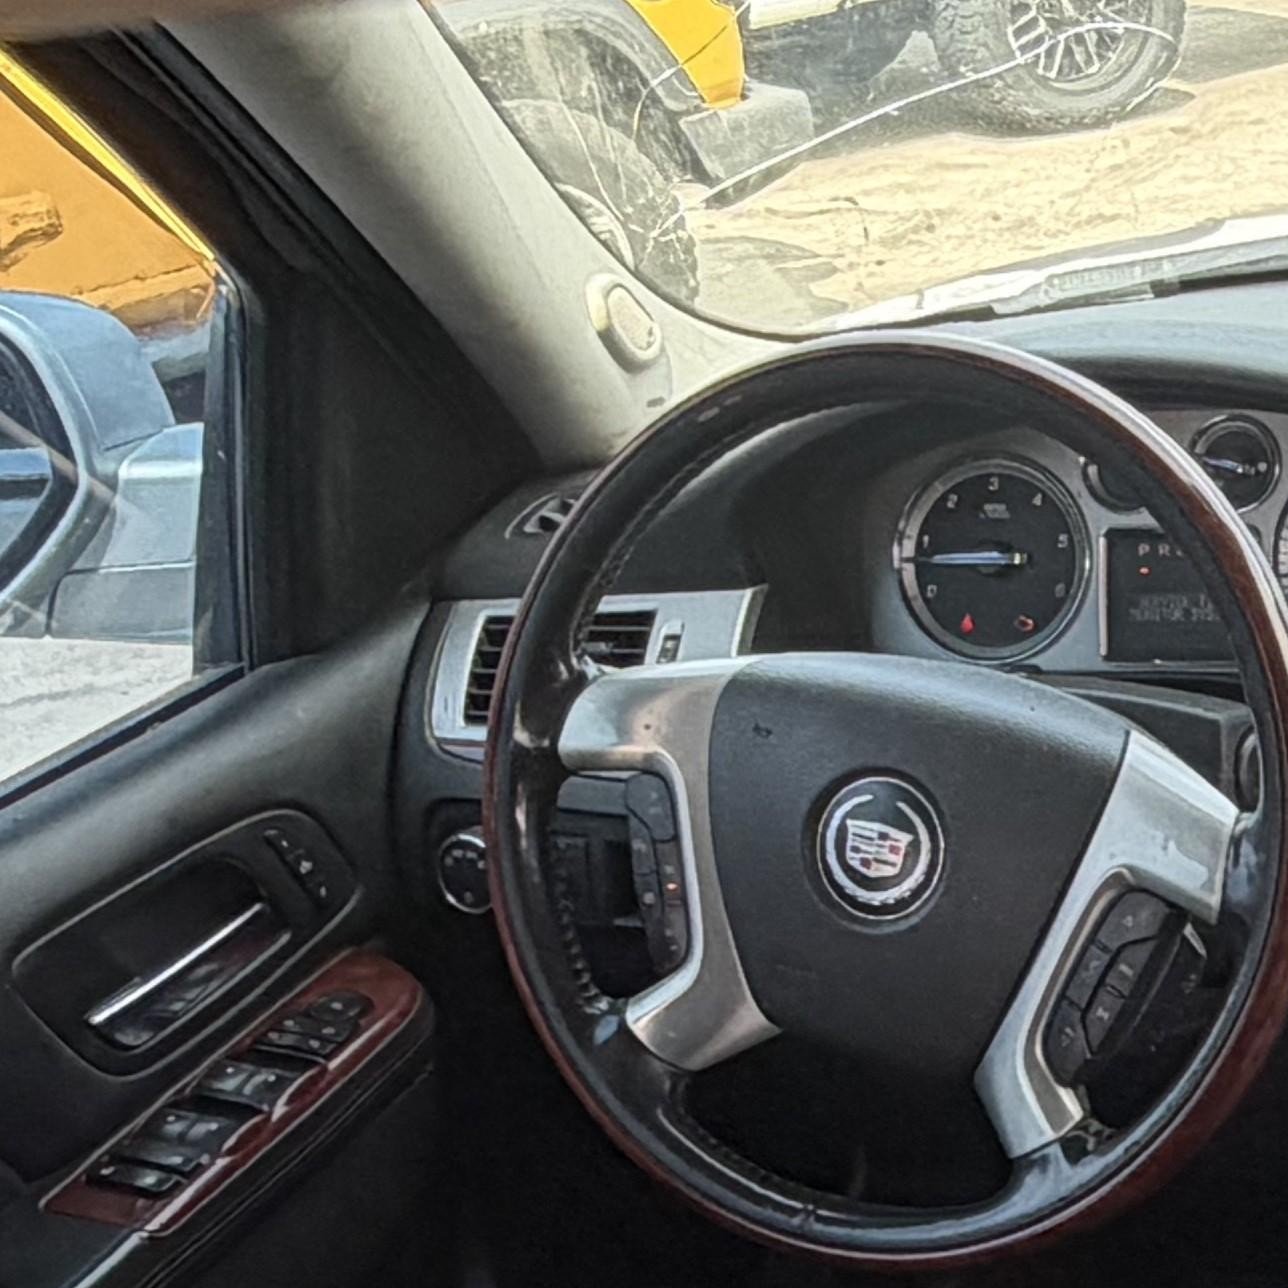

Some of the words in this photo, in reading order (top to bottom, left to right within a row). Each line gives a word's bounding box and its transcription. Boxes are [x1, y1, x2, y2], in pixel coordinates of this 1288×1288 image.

[987, 476, 999, 491] 3
[946, 494, 958, 508] 2
[1031, 492, 1043, 507] 4
[921, 535, 930, 548] 1
[1057, 533, 1069, 548] 5
[1137, 543, 1151, 557] P
